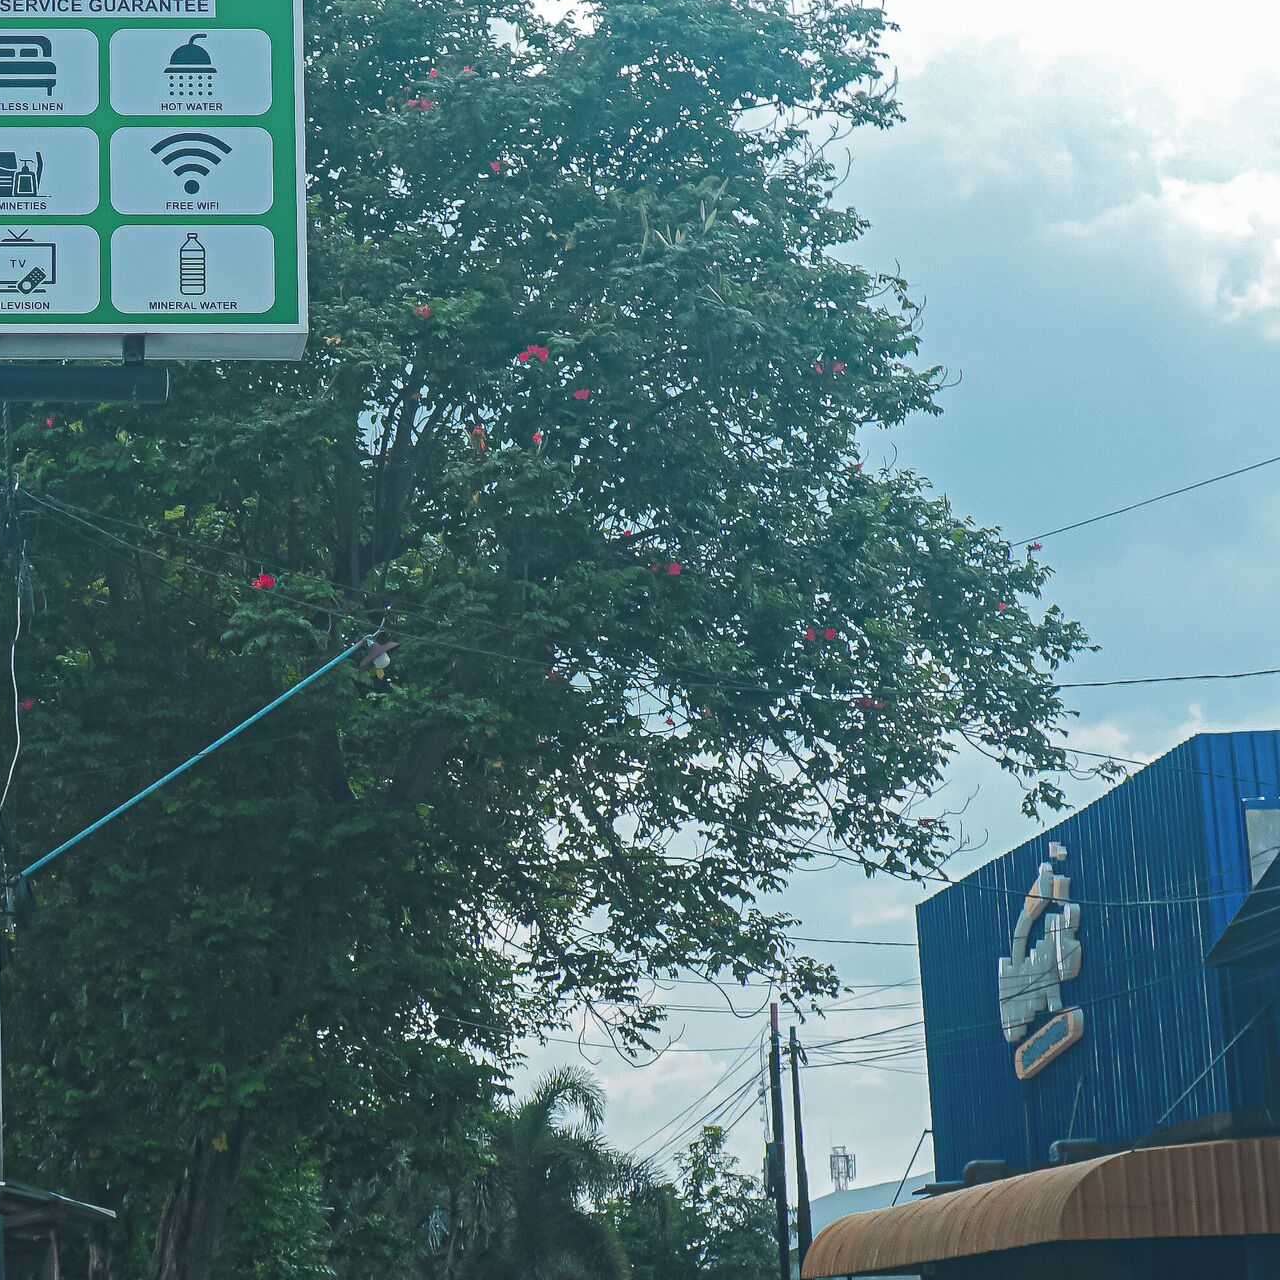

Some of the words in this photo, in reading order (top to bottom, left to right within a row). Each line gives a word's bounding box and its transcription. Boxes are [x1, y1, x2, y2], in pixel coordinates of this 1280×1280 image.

[31, 102, 64, 112] LINEN
[160, 102, 184, 112] HOT
[185, 102, 224, 112] WATER
[165, 201, 194, 211] FREE
[195, 201, 220, 211] WIFI
[9, 258, 27, 269] TV
[148, 300, 197, 311] MINERAL
[199, 300, 239, 311] WATER
